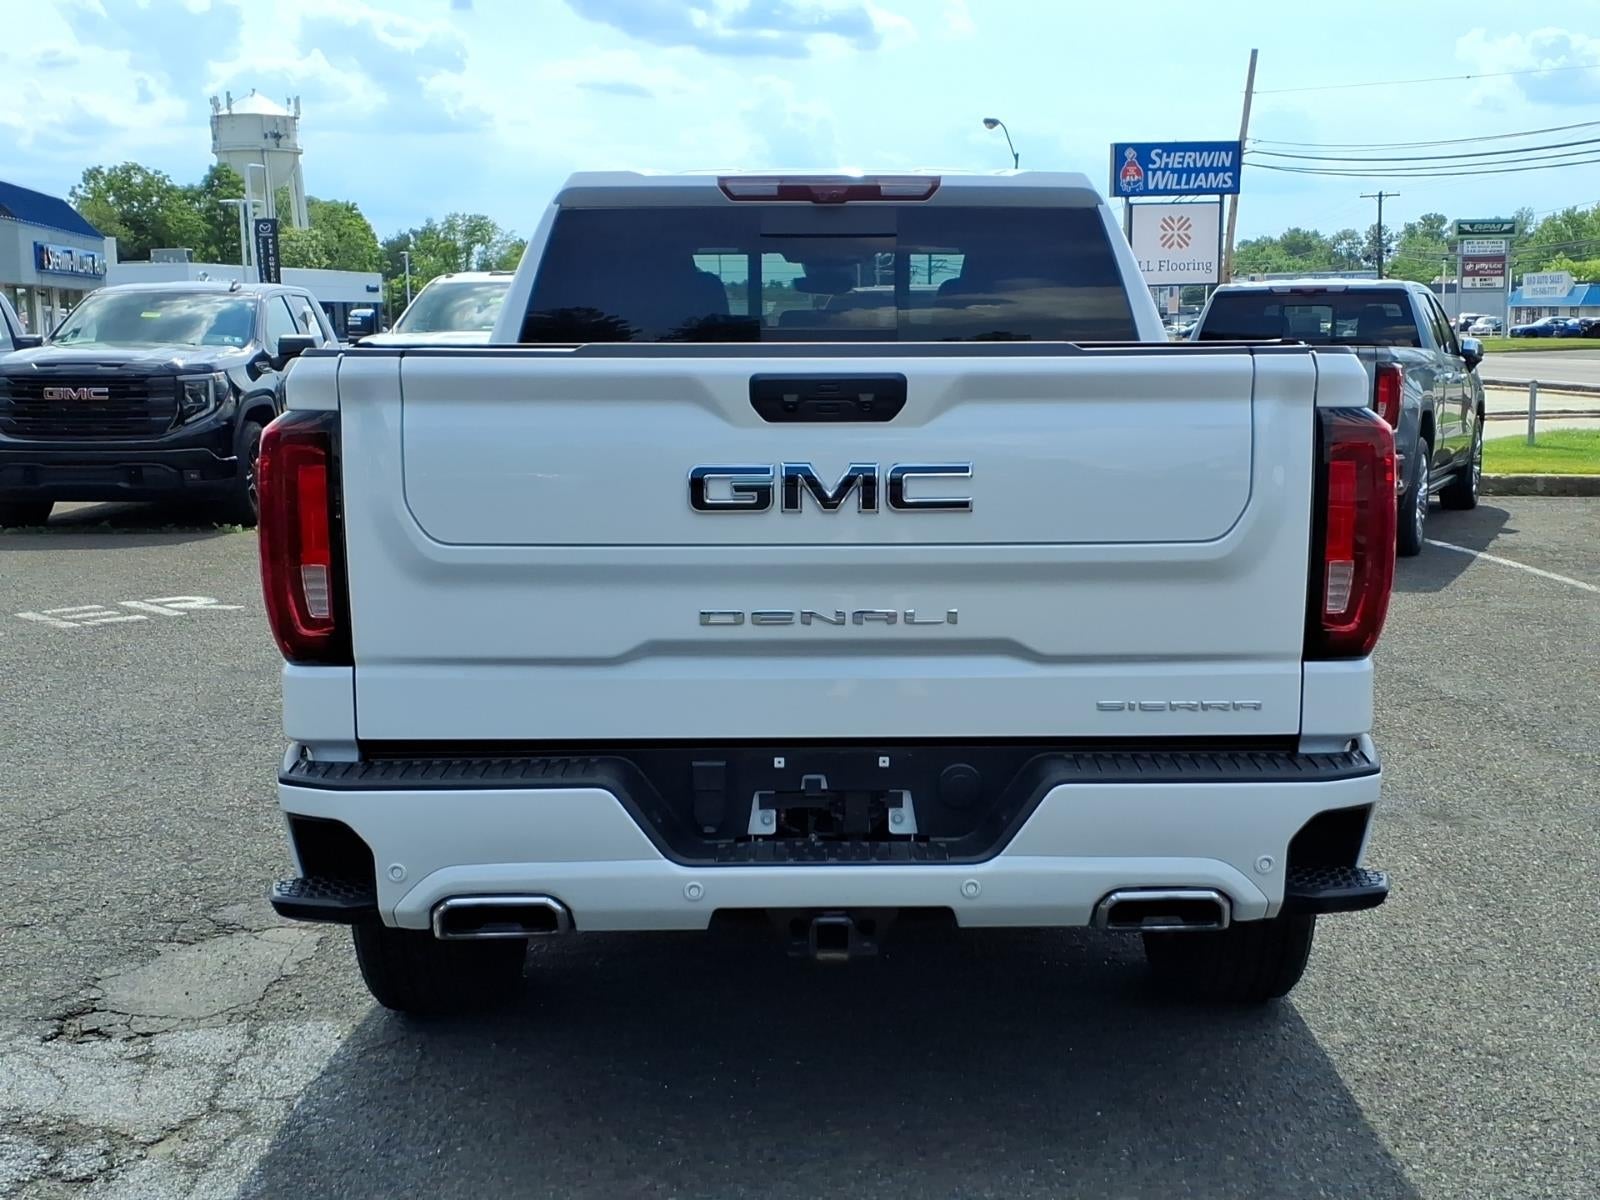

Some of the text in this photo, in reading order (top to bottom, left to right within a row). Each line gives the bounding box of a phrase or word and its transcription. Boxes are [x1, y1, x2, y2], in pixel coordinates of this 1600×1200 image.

[1148, 149, 1232, 169] SHERWIN
[1147, 171, 1233, 190] WILLIAMS
[1158, 259, 1212, 273] Flooring
[43, 387, 109, 400] GMC
[688, 462, 973, 513] GMC
[699, 609, 958, 625] DENALI
[1096, 700, 1263, 712] SIERRA
